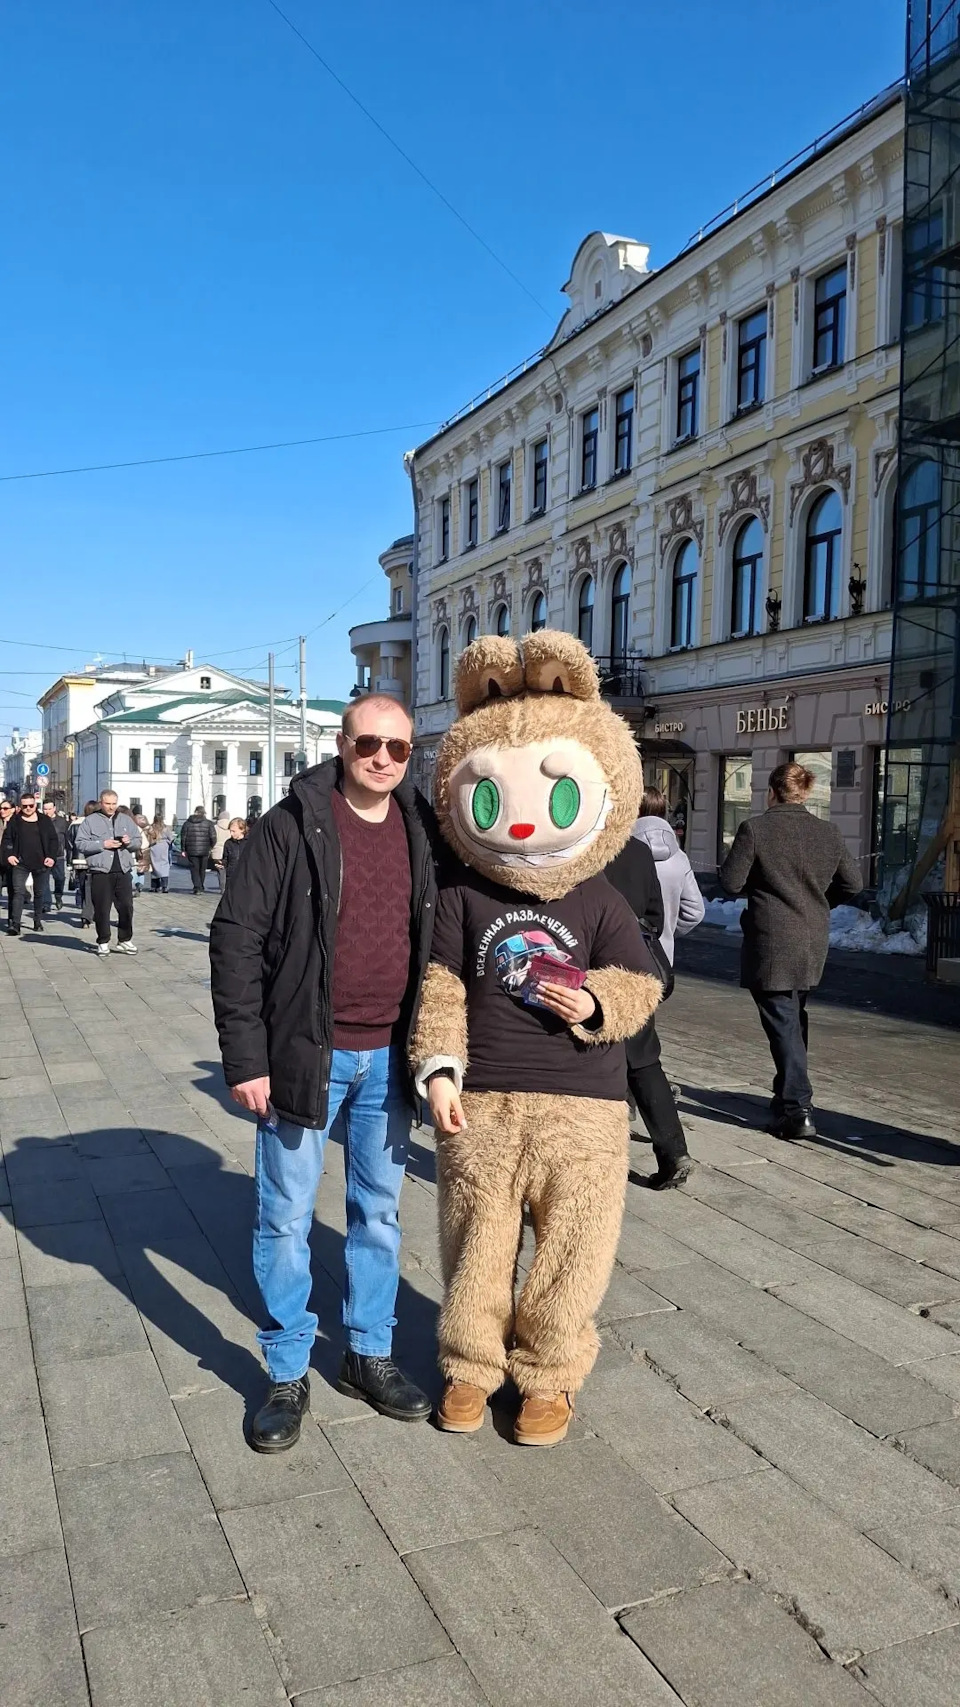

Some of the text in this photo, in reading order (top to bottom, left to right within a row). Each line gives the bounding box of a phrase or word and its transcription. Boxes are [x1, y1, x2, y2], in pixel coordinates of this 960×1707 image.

[655, 722, 683, 733] БИСТРО
[476, 918, 506, 977] ВСЕЛЕННАЯ
[505, 910, 578, 948] РАЗВЛЕЧЕНИЙ
